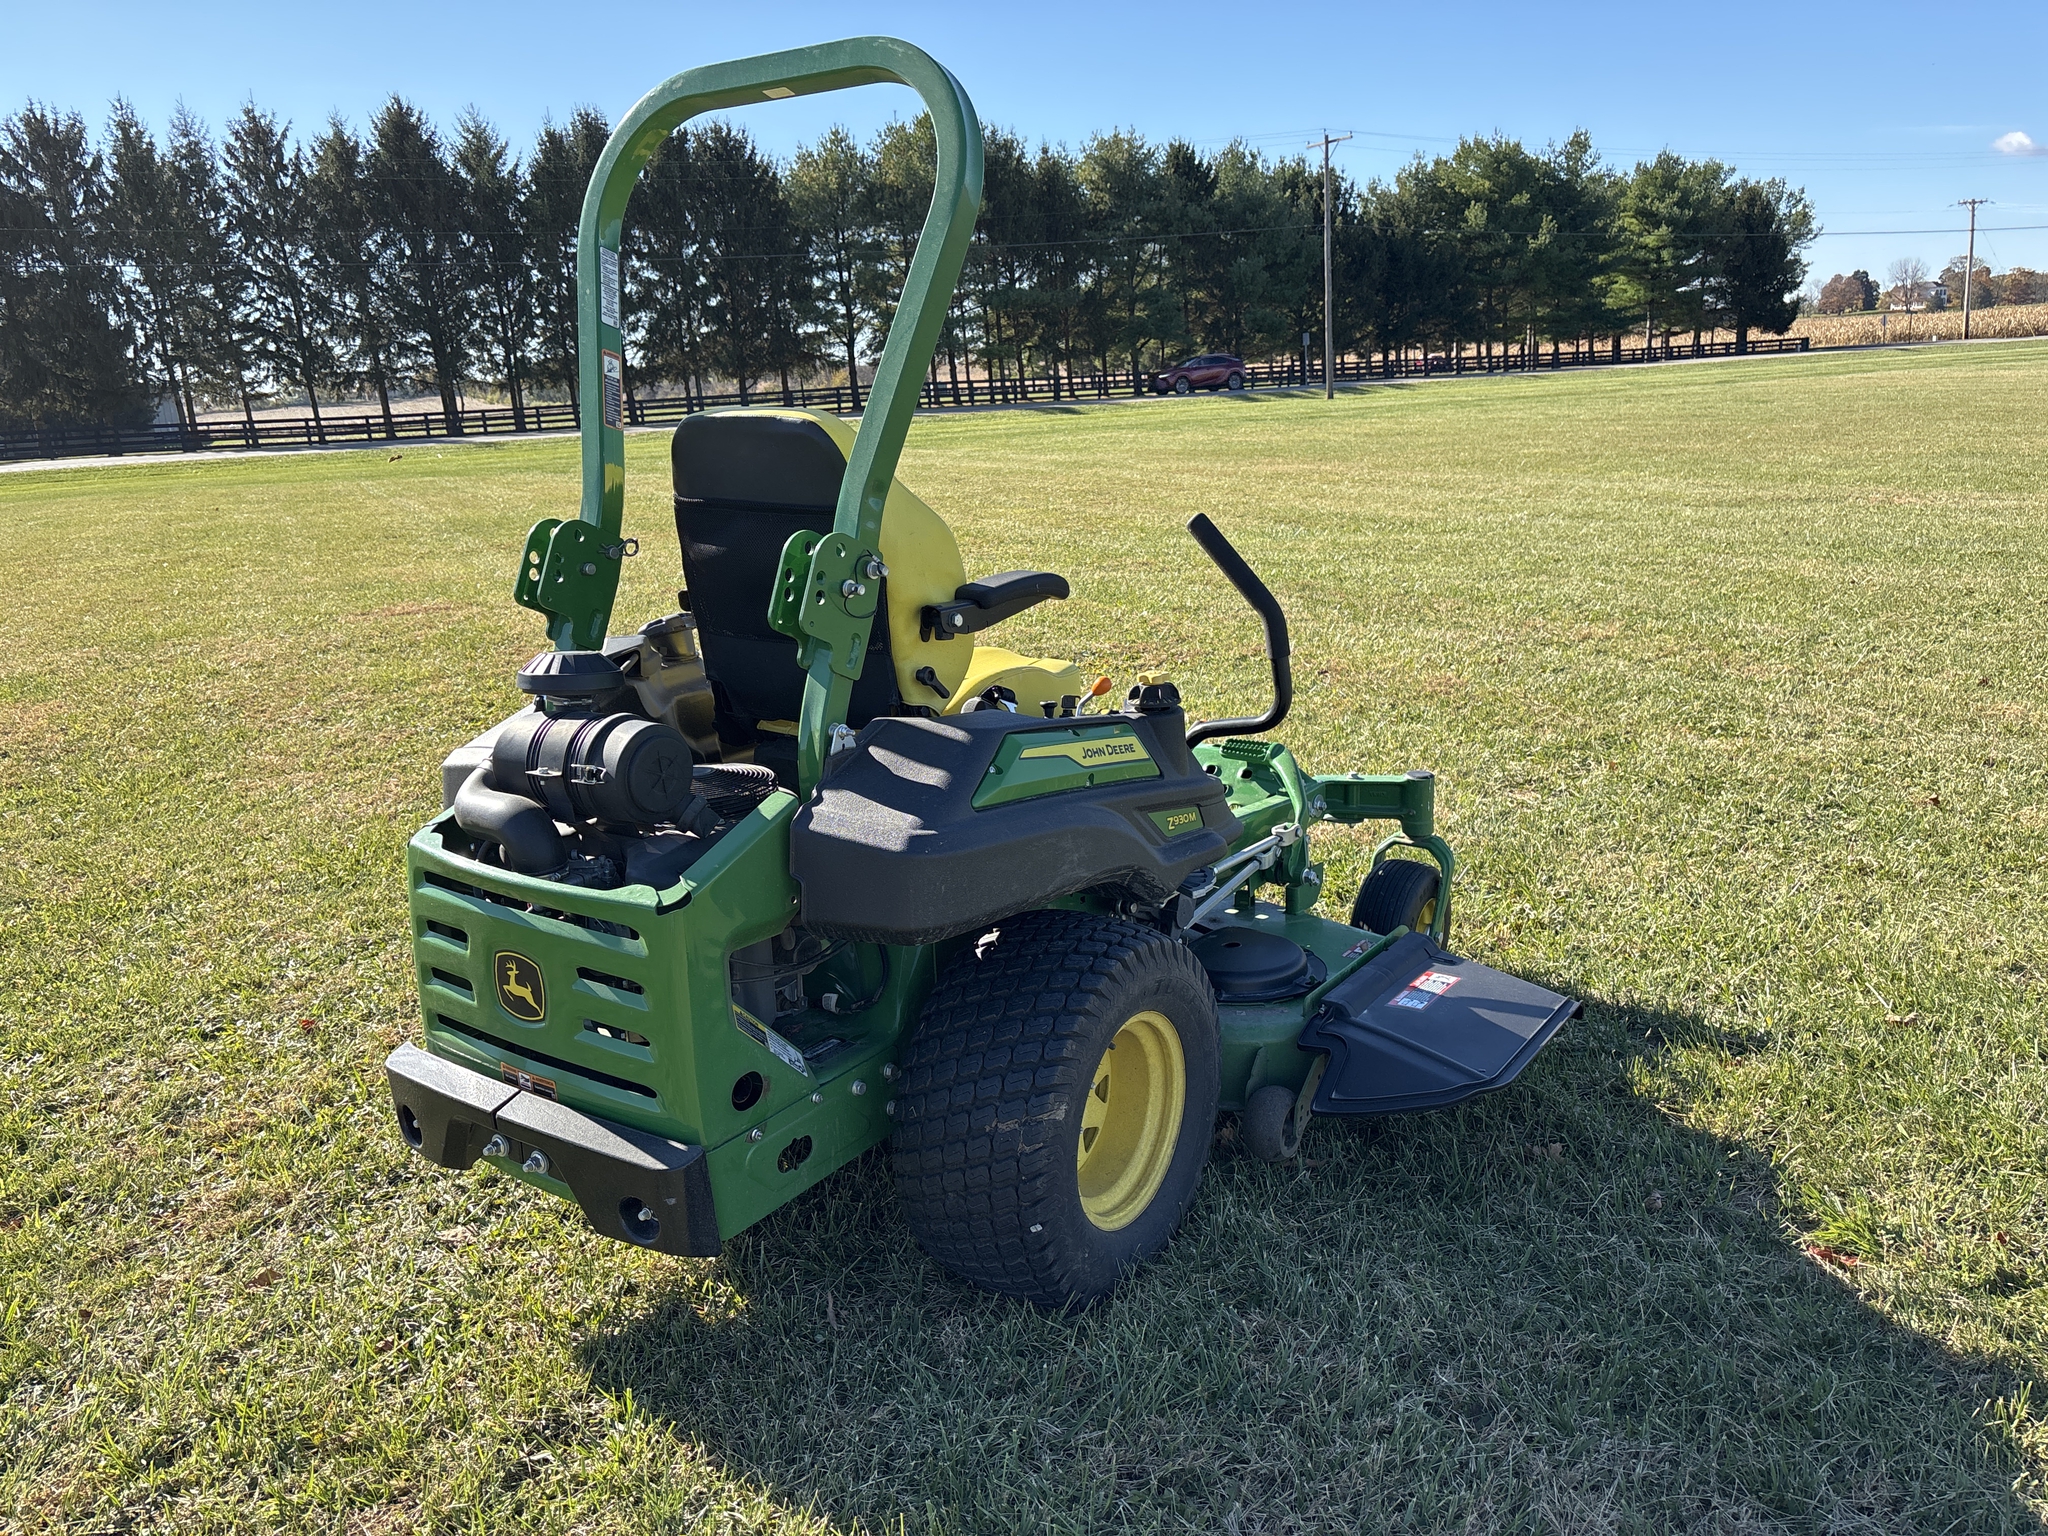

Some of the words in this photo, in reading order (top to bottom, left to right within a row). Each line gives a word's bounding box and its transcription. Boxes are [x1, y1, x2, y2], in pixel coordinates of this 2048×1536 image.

[1082, 746, 1106, 760] JOHN
[1105, 743, 1136, 756] DEERE
[1166, 811, 1197, 831] Z930M
